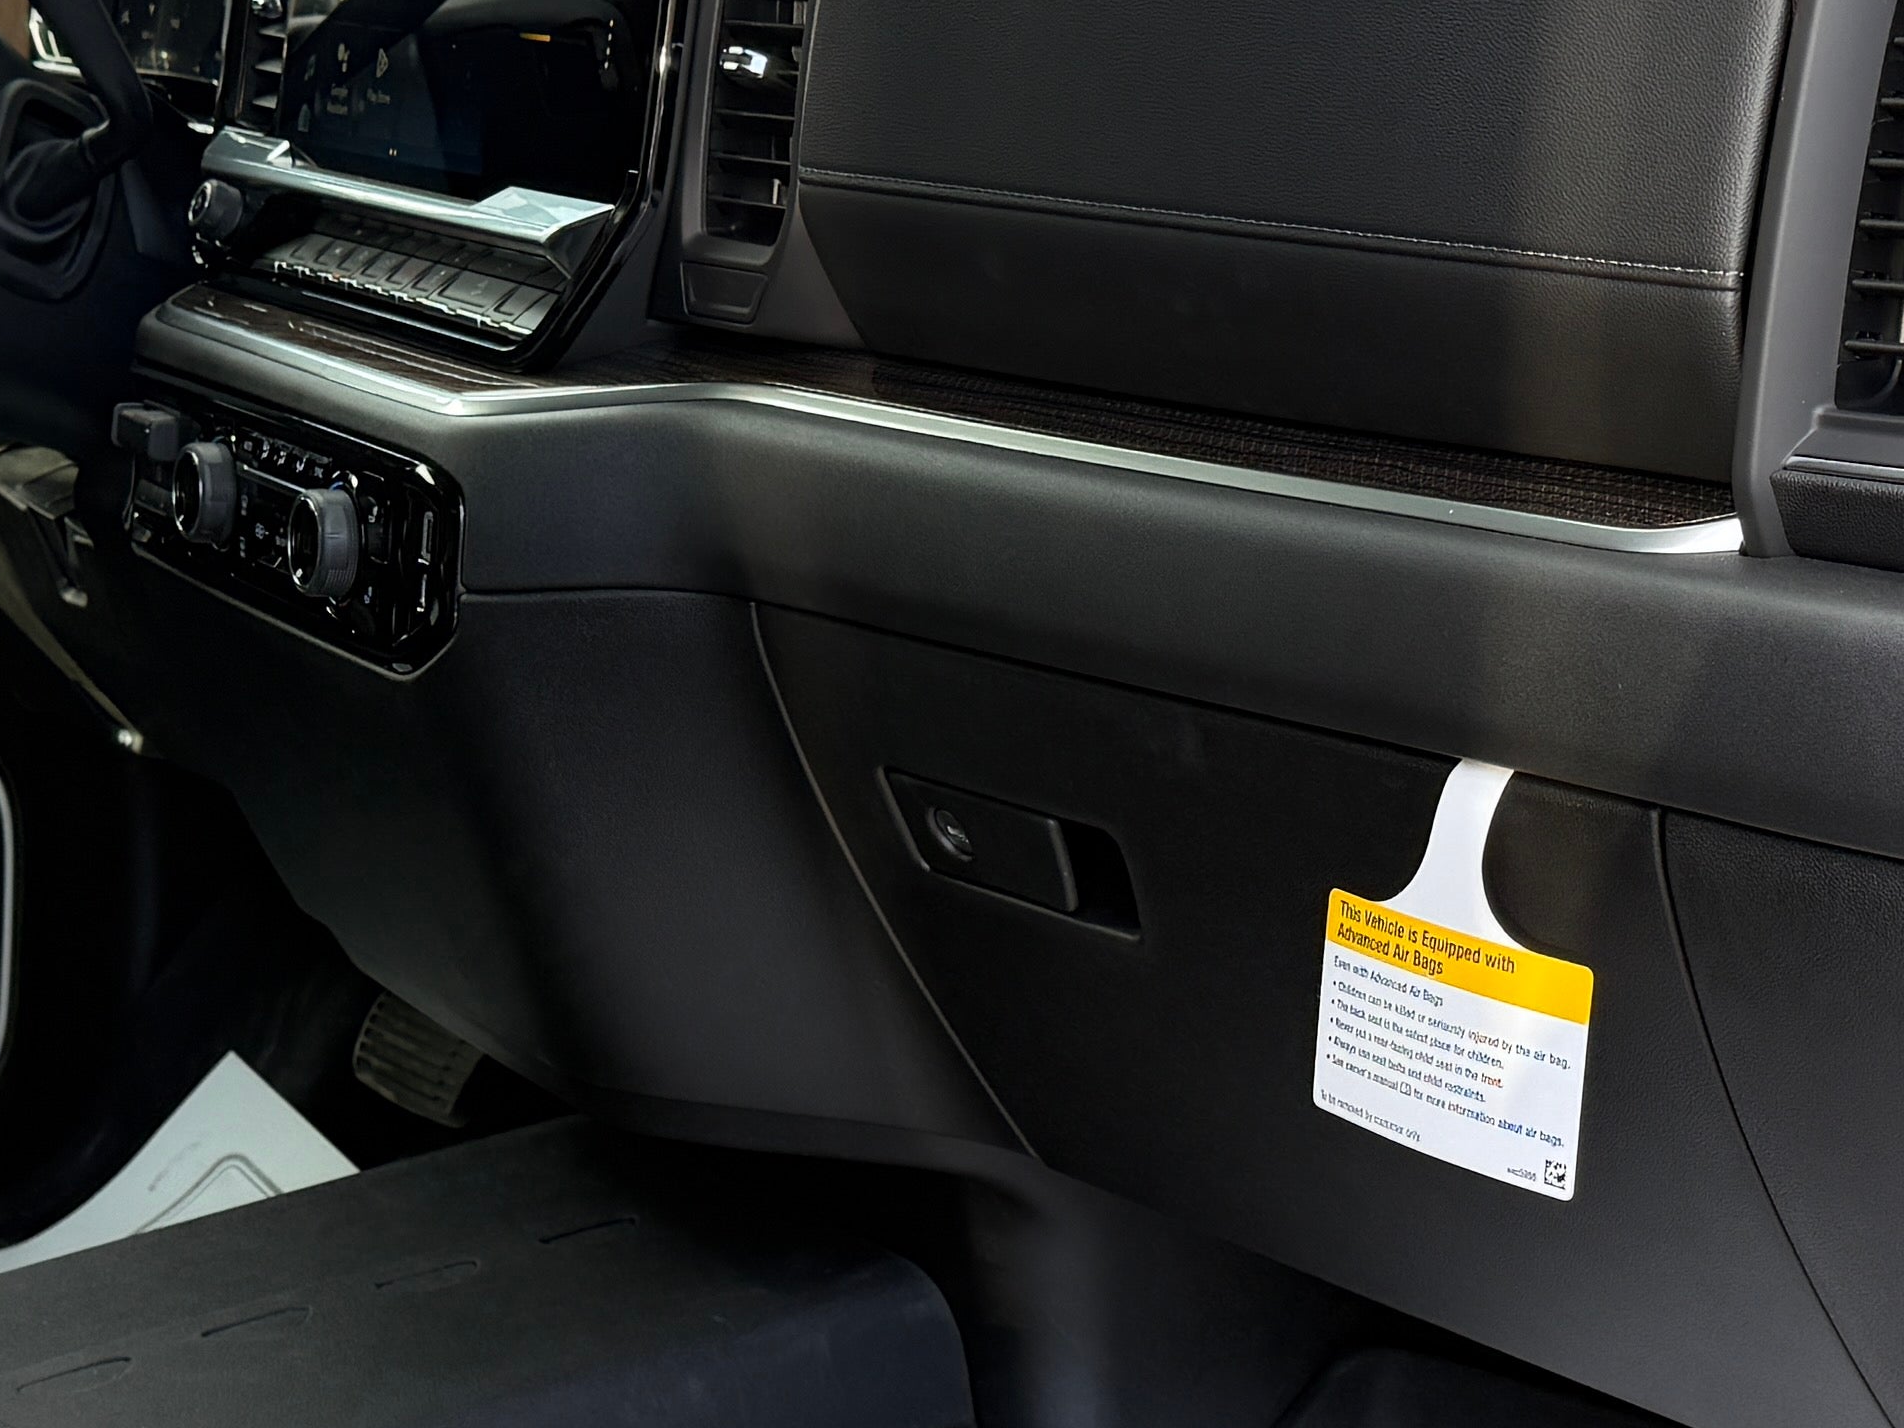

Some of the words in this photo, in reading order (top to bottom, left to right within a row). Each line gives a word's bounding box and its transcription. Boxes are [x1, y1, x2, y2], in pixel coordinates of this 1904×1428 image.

[1337, 922, 1390, 957] Advanced
[1393, 943, 1409, 963] Air
[1413, 950, 1443, 977] Bags
[1340, 900, 1361, 923] This
[1365, 910, 1404, 939] Vehicle
[1408, 928, 1418, 944] is
[1422, 930, 1481, 964] Equipped
[1485, 953, 1514, 975] with
